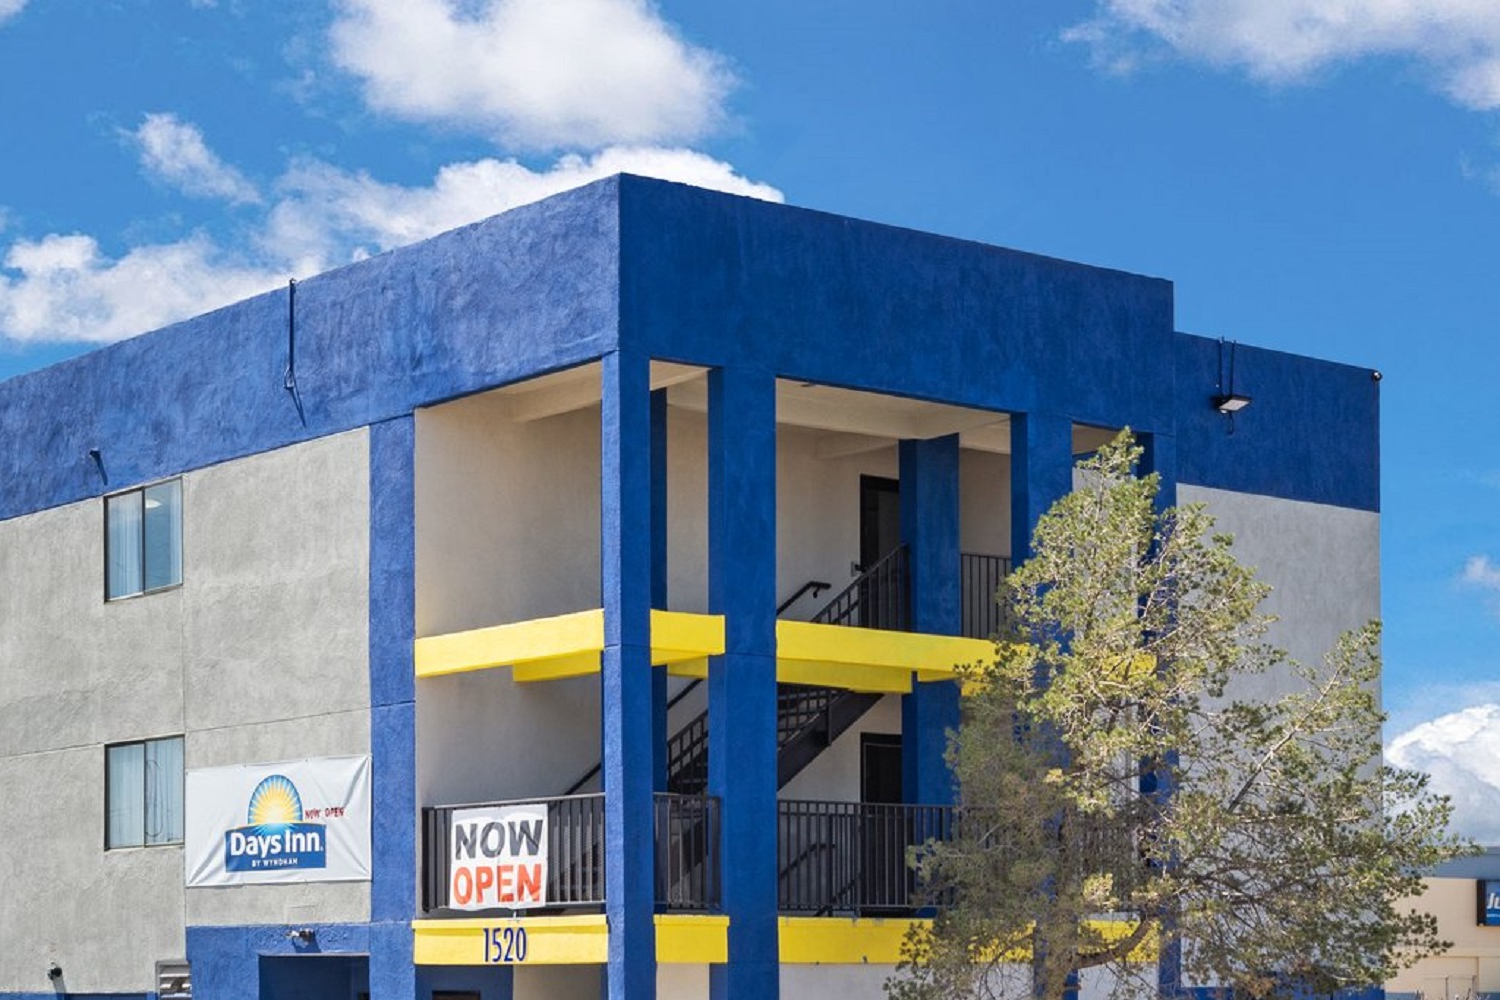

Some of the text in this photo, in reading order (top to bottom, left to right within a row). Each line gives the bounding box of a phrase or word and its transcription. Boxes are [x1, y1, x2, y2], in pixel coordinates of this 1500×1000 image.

[230, 832, 282, 858] Days
[455, 819, 544, 860] NOW
[251, 859, 261, 867] BY
[453, 863, 542, 906] OPEN
[482, 927, 527, 963] 1520
